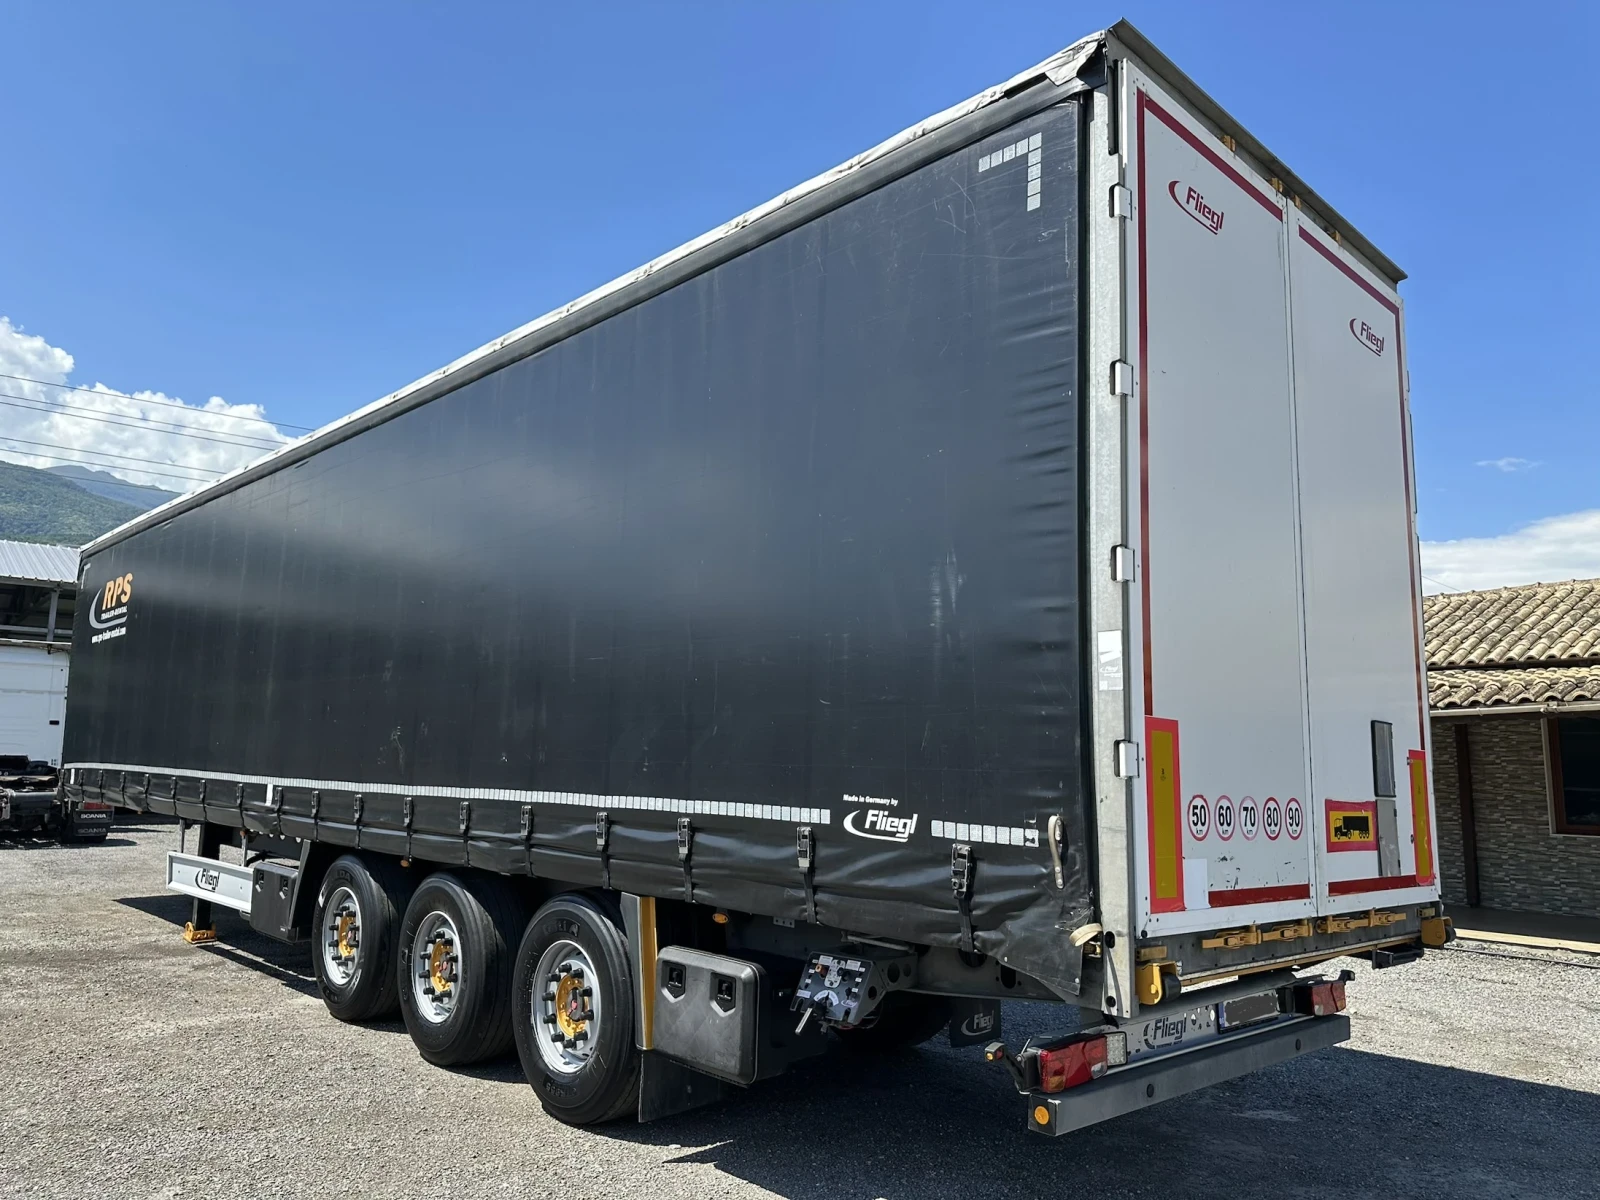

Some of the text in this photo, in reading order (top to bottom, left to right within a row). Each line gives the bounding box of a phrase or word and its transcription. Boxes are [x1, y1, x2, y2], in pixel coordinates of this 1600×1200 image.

[1185, 186, 1225, 231] Fliegl
[1360, 321, 1385, 354] Fliegl
[102, 573, 133, 610] RPS
[843, 794, 898, 807] Made in Germany by
[864, 809, 918, 838] Fliegl
[1192, 805, 1207, 827] 50
[1218, 805, 1232, 827] 60
[1243, 806, 1256, 827] 70
[1266, 807, 1279, 828] 80
[1288, 807, 1300, 828] 90
[1246, 828, 1254, 836] km
[1153, 1013, 1187, 1040] Fliegl
